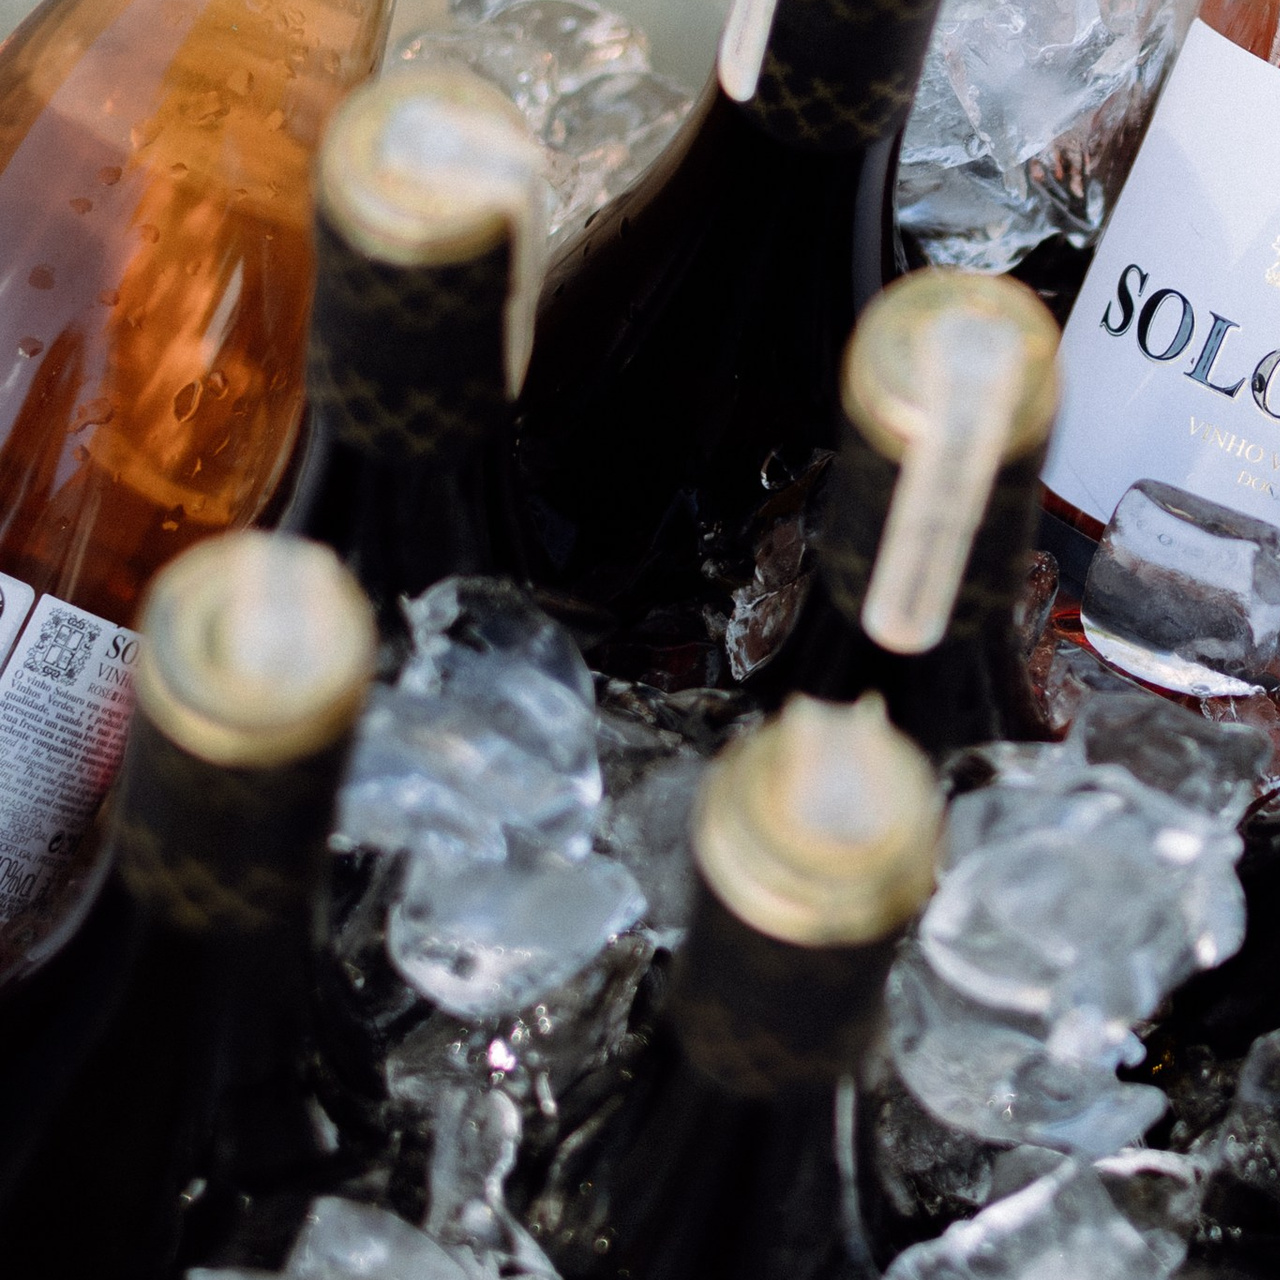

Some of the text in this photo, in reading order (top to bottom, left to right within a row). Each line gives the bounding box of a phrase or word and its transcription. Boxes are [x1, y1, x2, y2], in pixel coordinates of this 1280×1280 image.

[1189, 415, 1265, 464] VINHO
[11, 678, 41, 699] Vinhos
[48, 694, 76, 715] Verdes,
[27, 676, 52, 692] vinho
[53, 687, 85, 705] Solouro
[4, 690, 50, 716] qualidade,
[55, 712, 83, 728] usando
[1, 713, 18, 725] sua
[19, 718, 54, 740] frescura
[44, 719, 58, 730] um
[59, 724, 83, 739] aroma
[32, 737, 74, 758] companhia
[14, 753, 57, 774] indigenous
